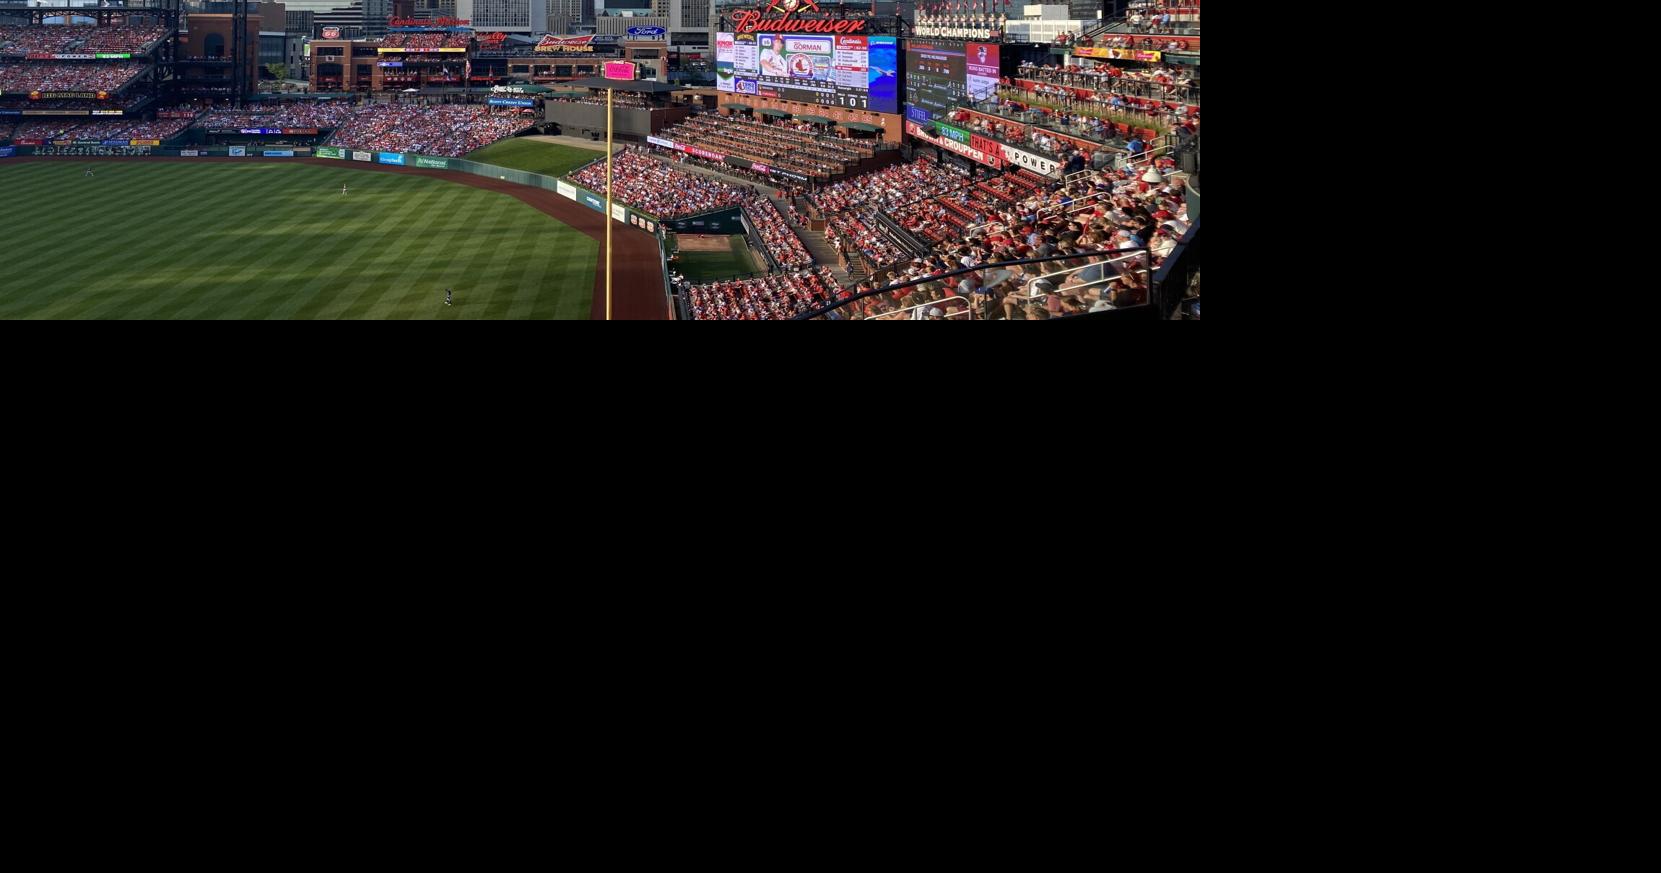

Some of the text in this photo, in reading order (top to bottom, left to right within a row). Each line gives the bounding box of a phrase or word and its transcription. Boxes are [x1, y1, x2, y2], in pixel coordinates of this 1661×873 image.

[731, 9, 866, 33] Budweiser
[634, 26, 660, 36] Ford
[915, 26, 991, 39] WORLD CHAMPIONS
[839, 97, 867, 108] 1 0 1
[911, 106, 927, 121] STIFEL
[941, 126, 964, 142] 83 MPH
[944, 137, 984, 161] CROUPPEN
[971, 135, 1000, 156] THAT'S A
[1014, 152, 1057, 174] POWER
